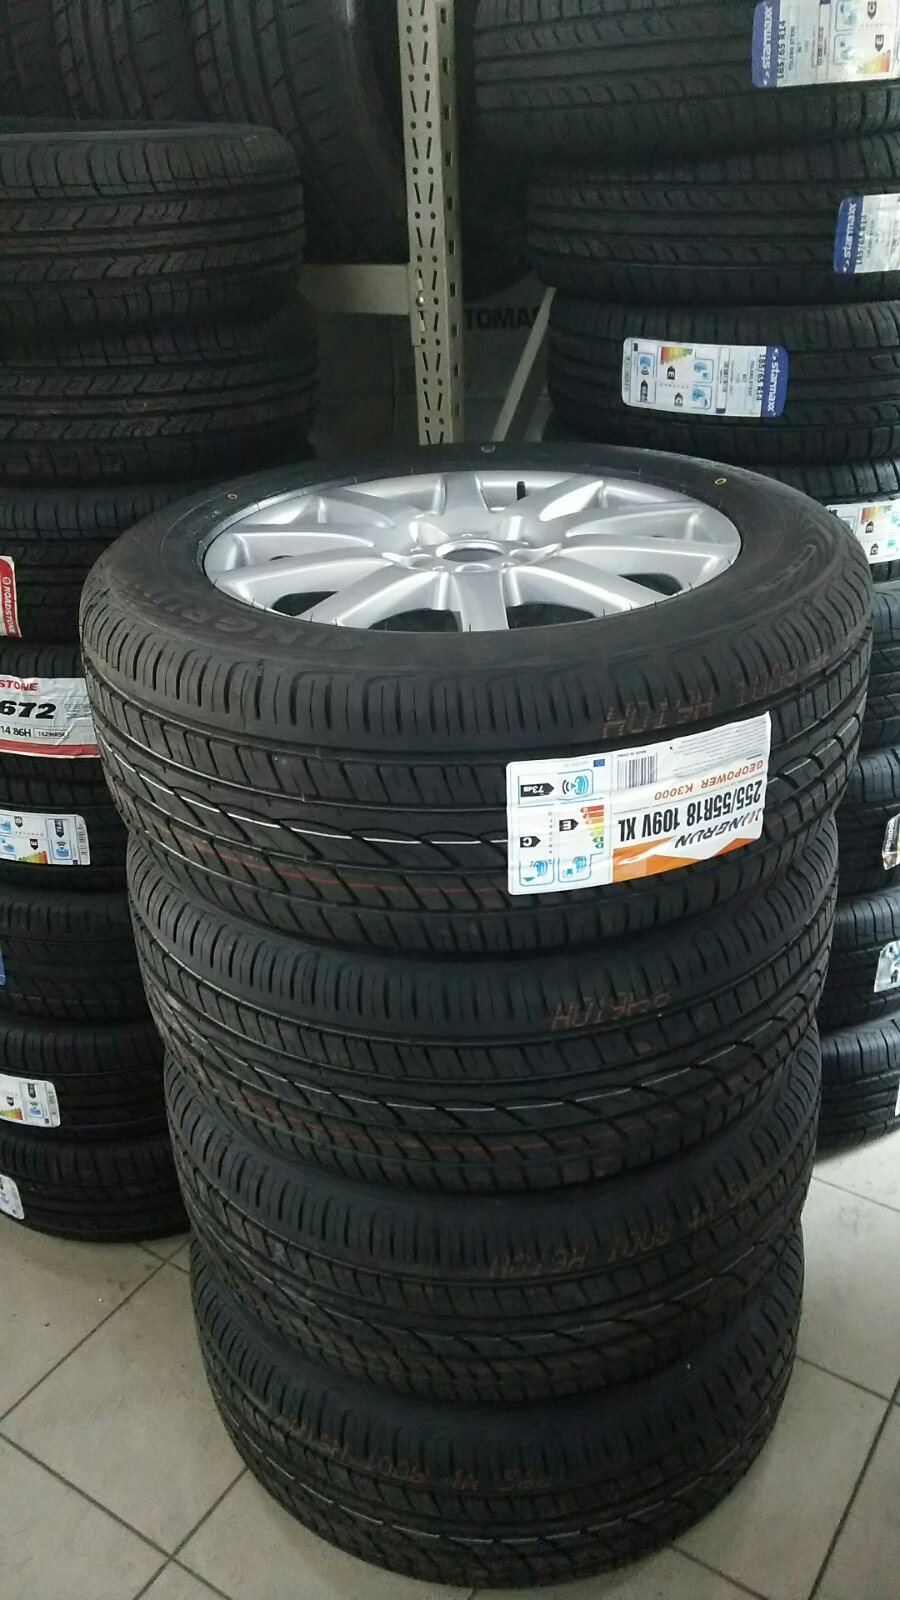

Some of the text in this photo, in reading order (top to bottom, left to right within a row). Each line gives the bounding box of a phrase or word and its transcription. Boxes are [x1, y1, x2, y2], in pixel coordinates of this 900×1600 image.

[762, 5, 773, 69] starmaxx
[842, 203, 857, 258] starmaxx
[767, 361, 780, 411] starmaxx
[3, 585, 16, 634] ROADSTONE
[0, 700, 56, 719] 672
[13, 727, 31, 737] 86H
[654, 759, 763, 801] GEOPOWER K3000
[563, 820, 571, 830] E
[617, 780, 763, 842] 255/55R18 109V XL
[523, 838, 532, 846] C
